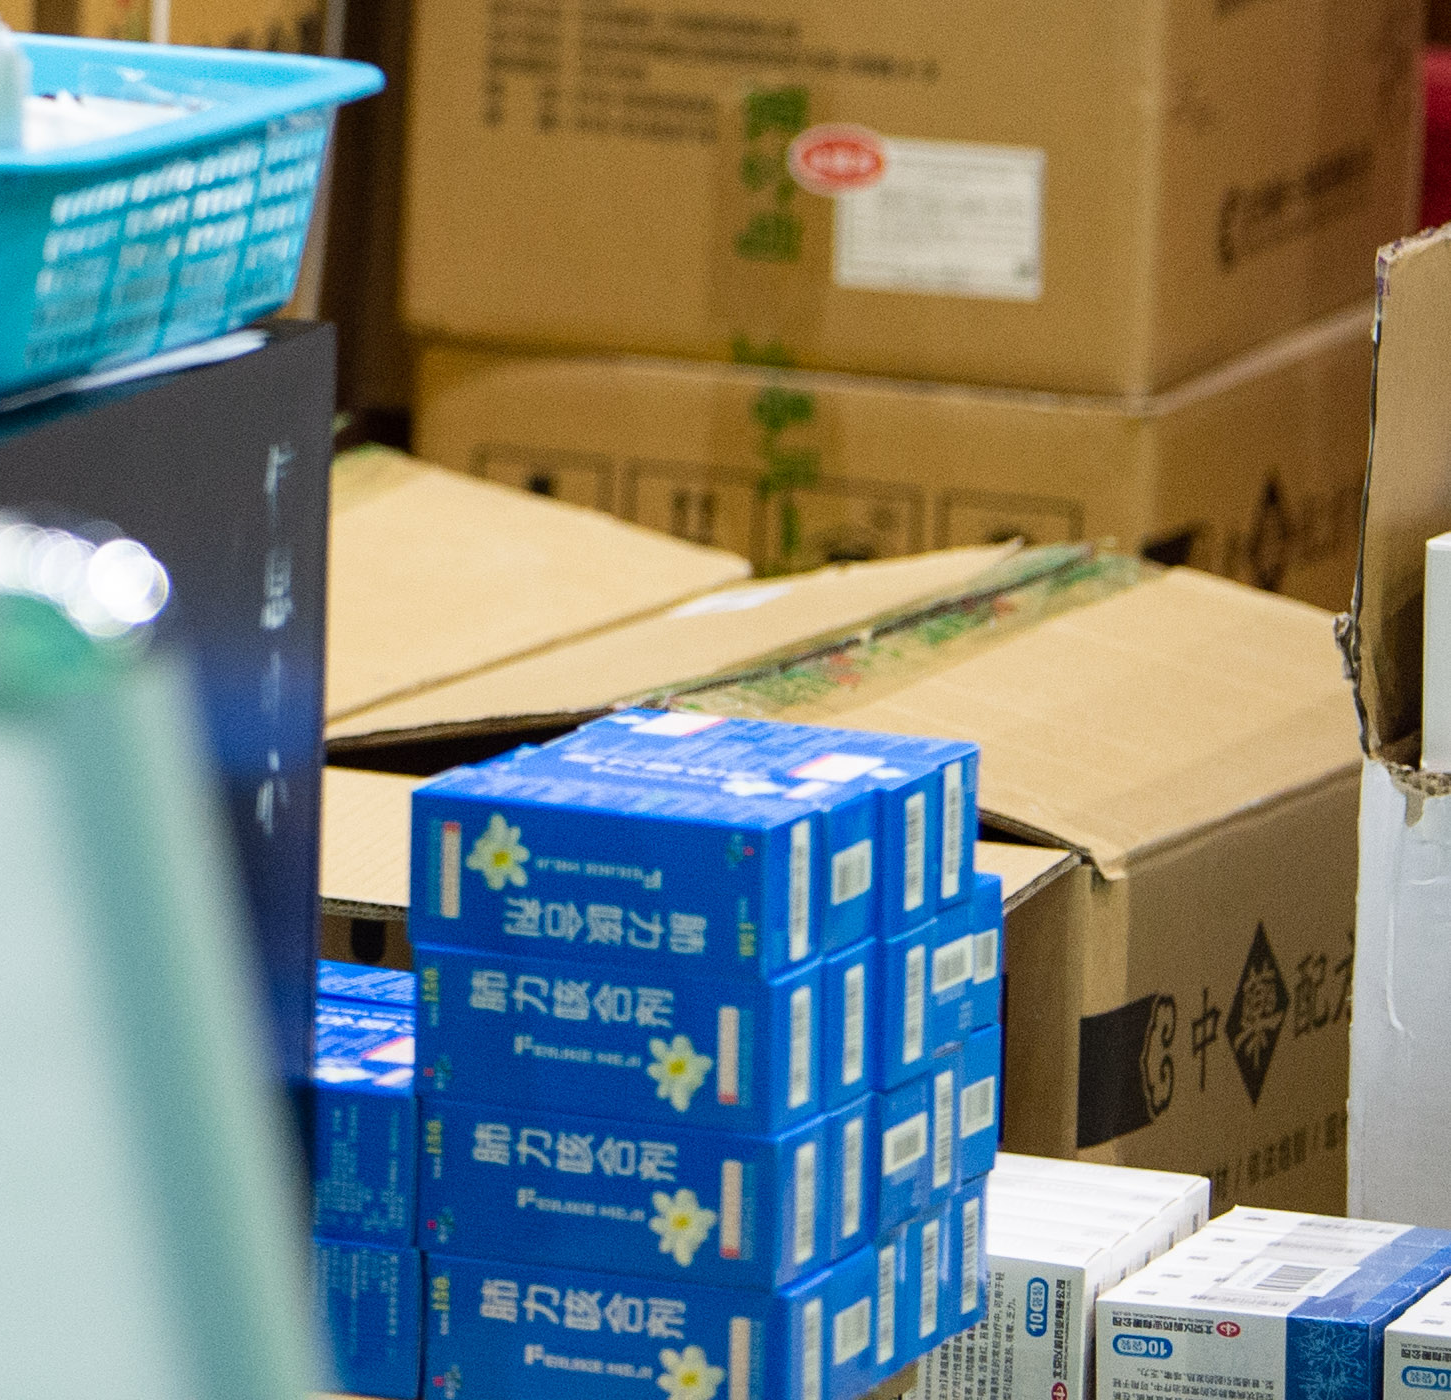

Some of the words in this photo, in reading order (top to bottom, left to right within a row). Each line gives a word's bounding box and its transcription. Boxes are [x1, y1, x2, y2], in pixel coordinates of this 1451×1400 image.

[503, 896, 707, 955] 肺力咳合剂
[469, 969, 675, 1028] 肺力咳合剂
[472, 1122, 679, 1182] 肺力咳合剂
[479, 1278, 687, 1340] 肺力咳合剂
[1409, 1370, 1451, 1389] 0袋装
